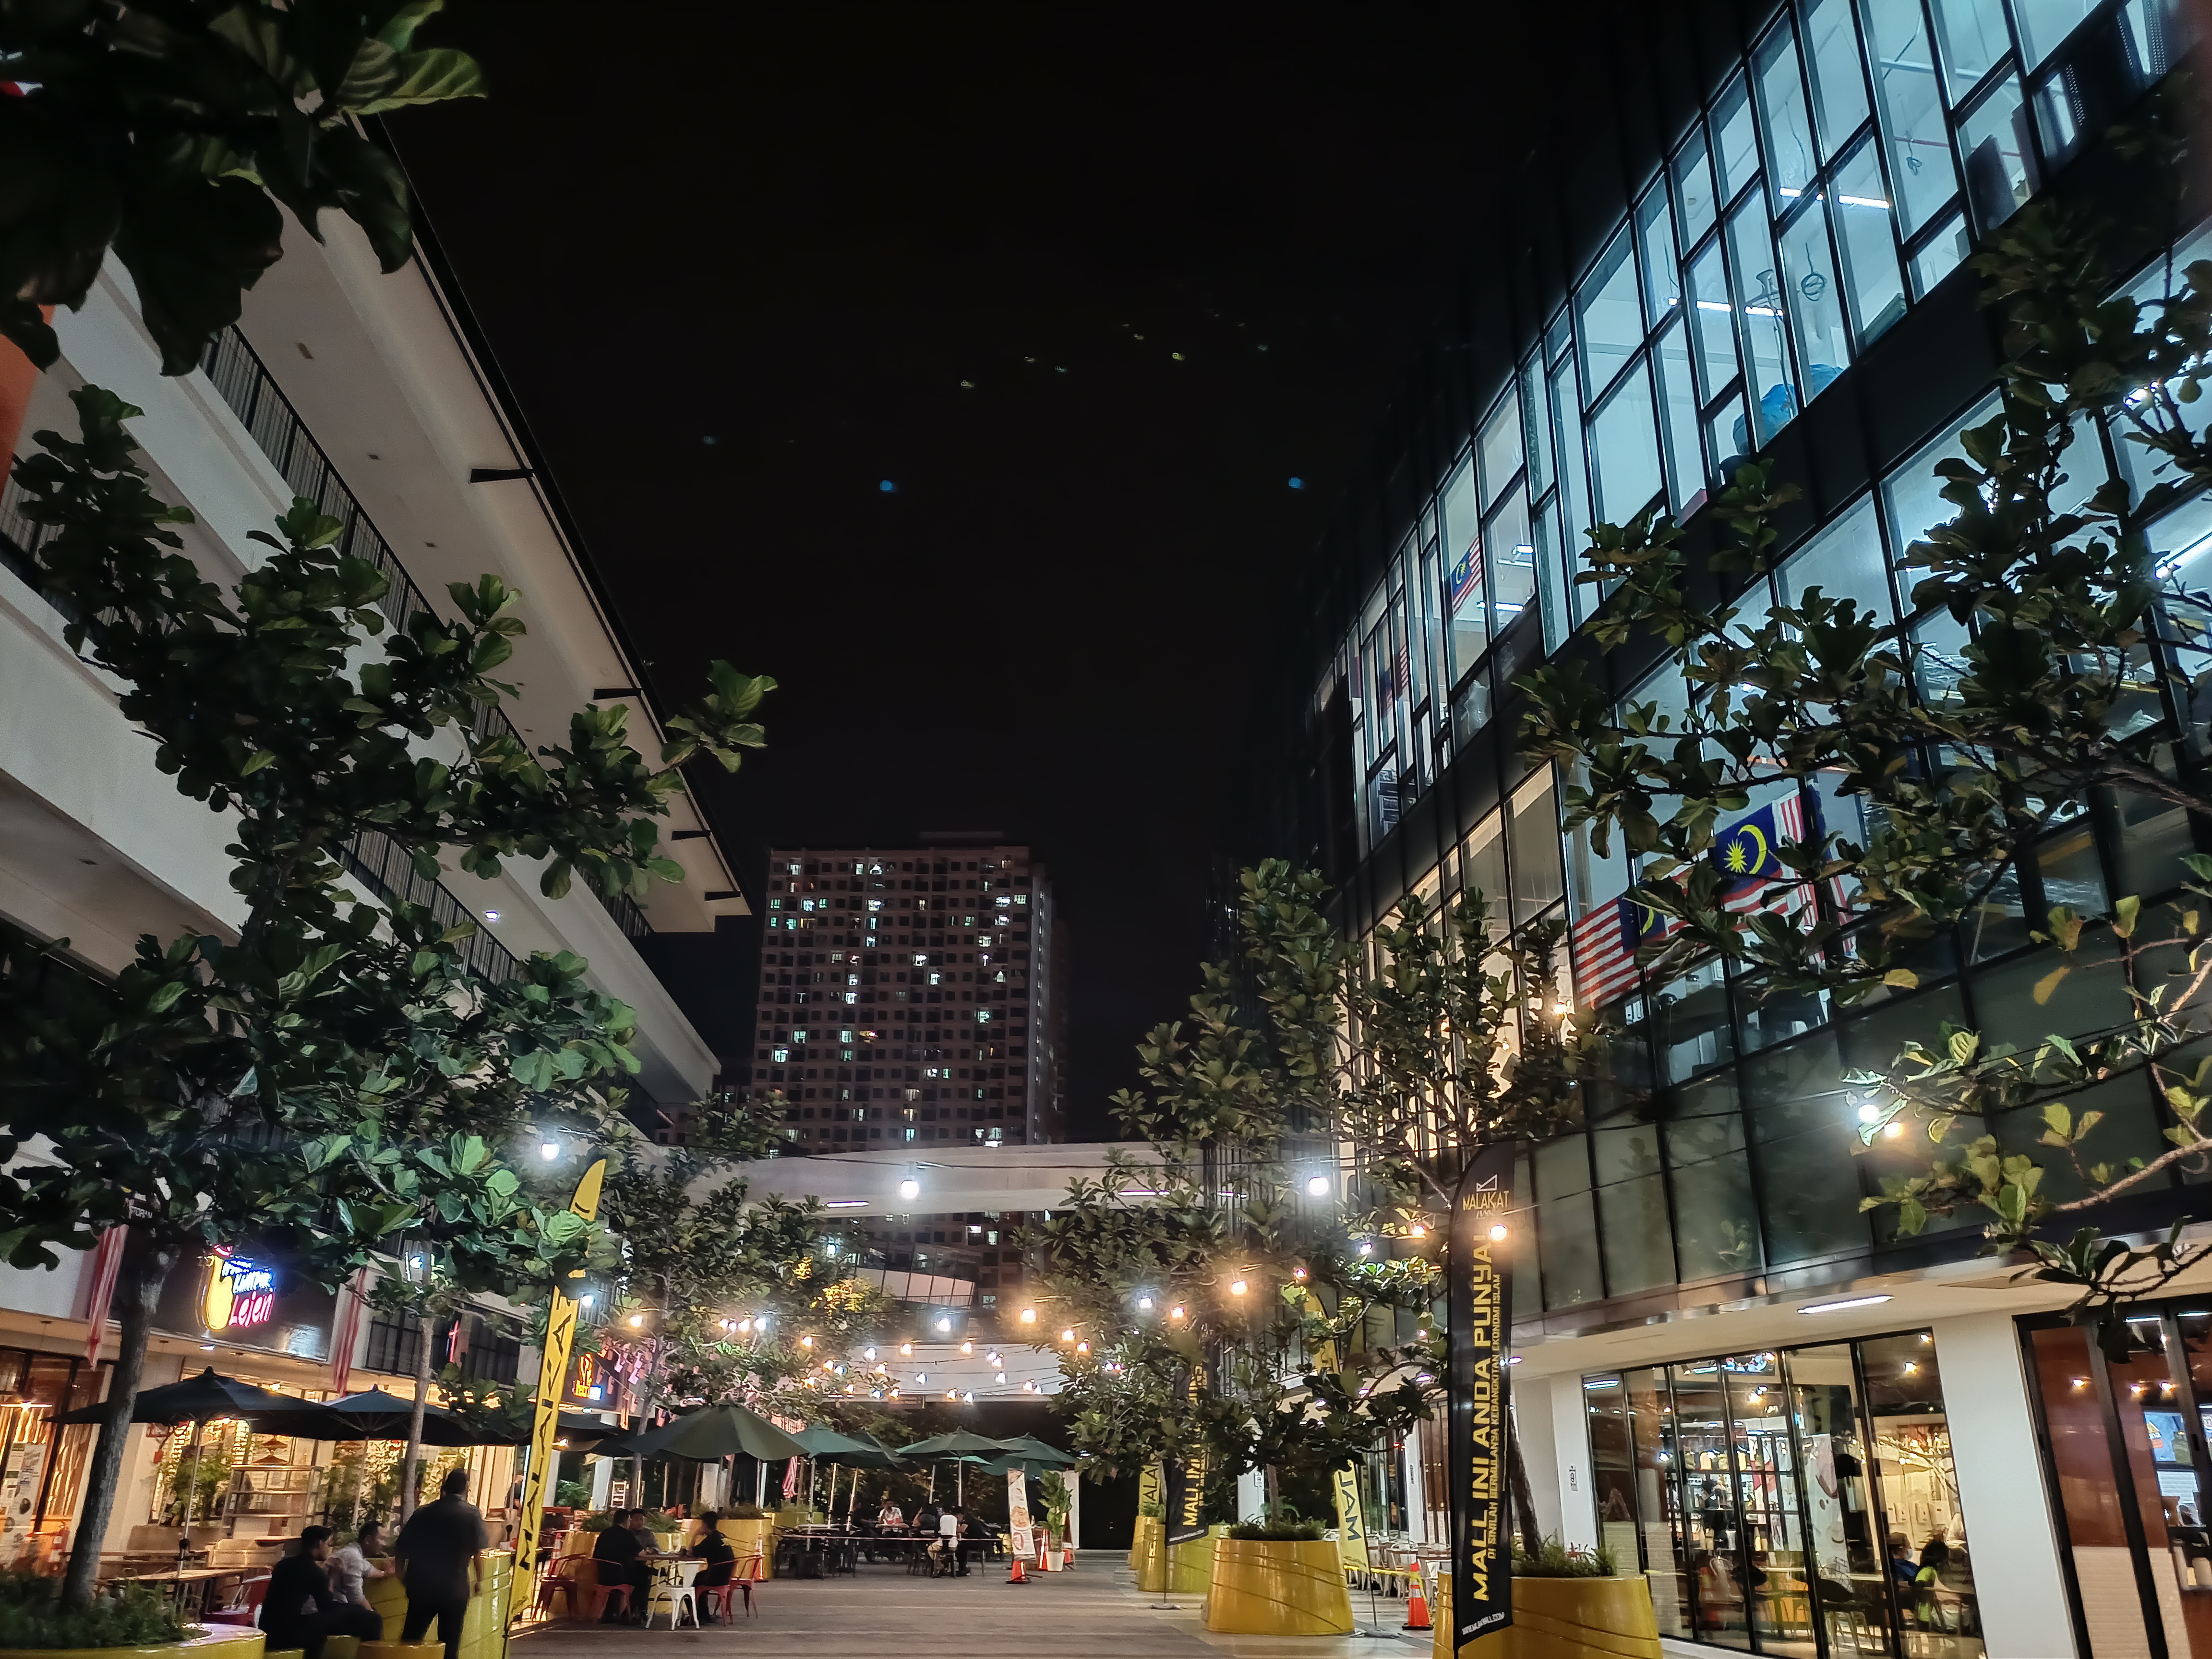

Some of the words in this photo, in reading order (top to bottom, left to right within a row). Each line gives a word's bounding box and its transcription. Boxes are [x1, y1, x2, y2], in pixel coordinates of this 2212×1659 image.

[1463, 1190, 1510, 1211] MALAKAT
[228, 1290, 274, 1328] Lejen
[1491, 1274, 1501, 1304] ISLAM
[1491, 1306, 1501, 1351] EKONOMI
[1472, 1358, 1491, 1448] ANDA
[1472, 1457, 1490, 1499] INI
[1488, 1502, 1498, 1545] SINILAH
[1471, 1510, 1490, 1601] MALL
